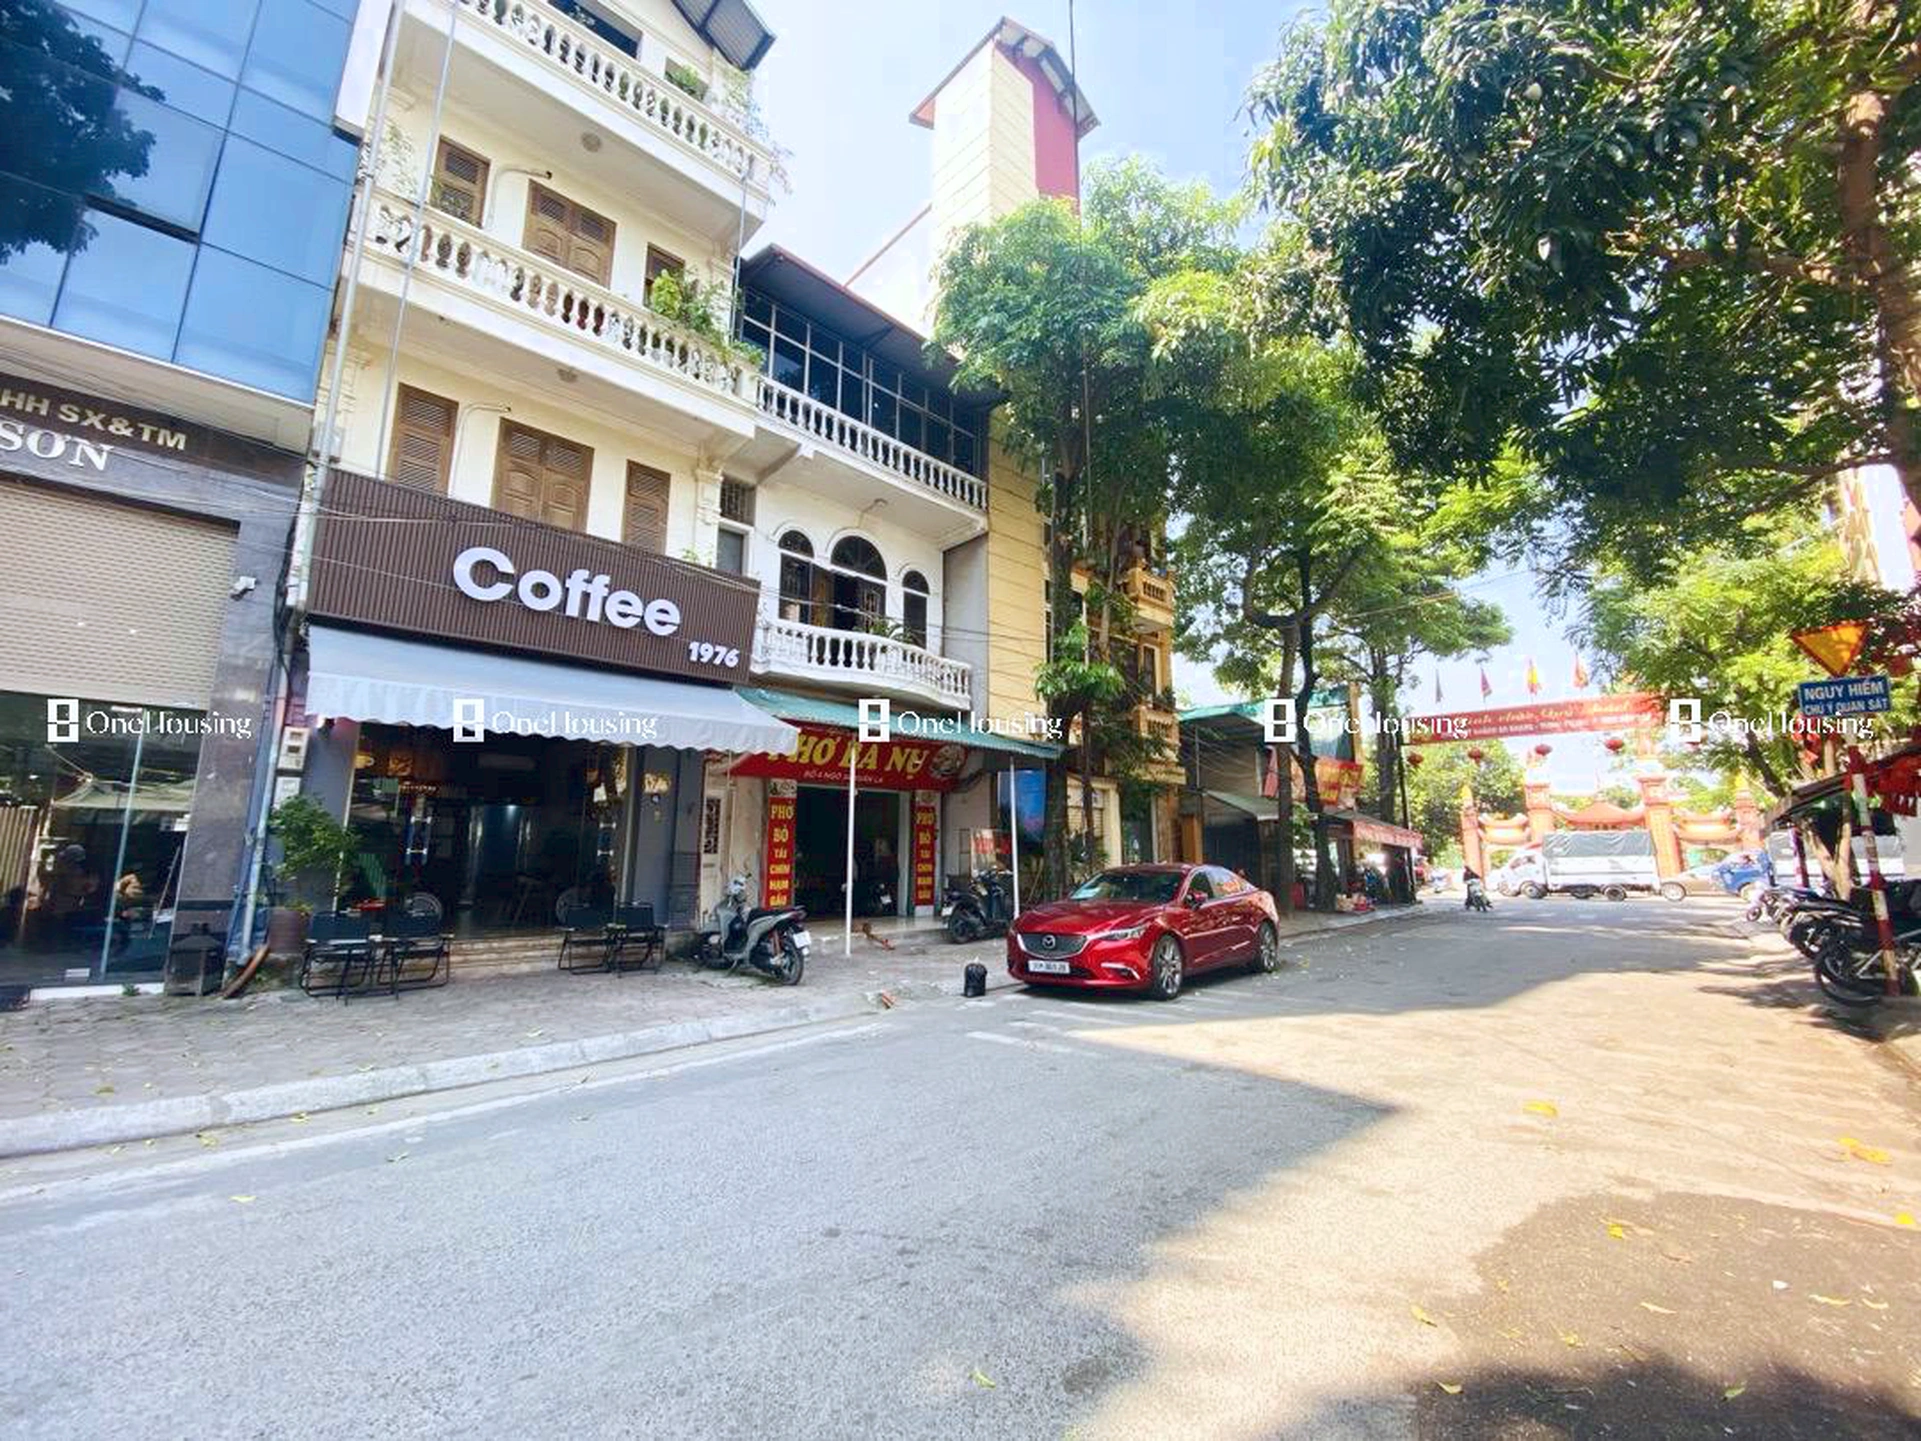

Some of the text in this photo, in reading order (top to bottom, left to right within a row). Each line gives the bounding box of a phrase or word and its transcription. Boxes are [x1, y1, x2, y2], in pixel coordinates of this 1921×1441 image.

[56, 403, 188, 450] SX&TM
[452, 546, 681, 637] Coffee
[688, 640, 740, 668] 1976
[1804, 685, 1844, 701] NGUY
